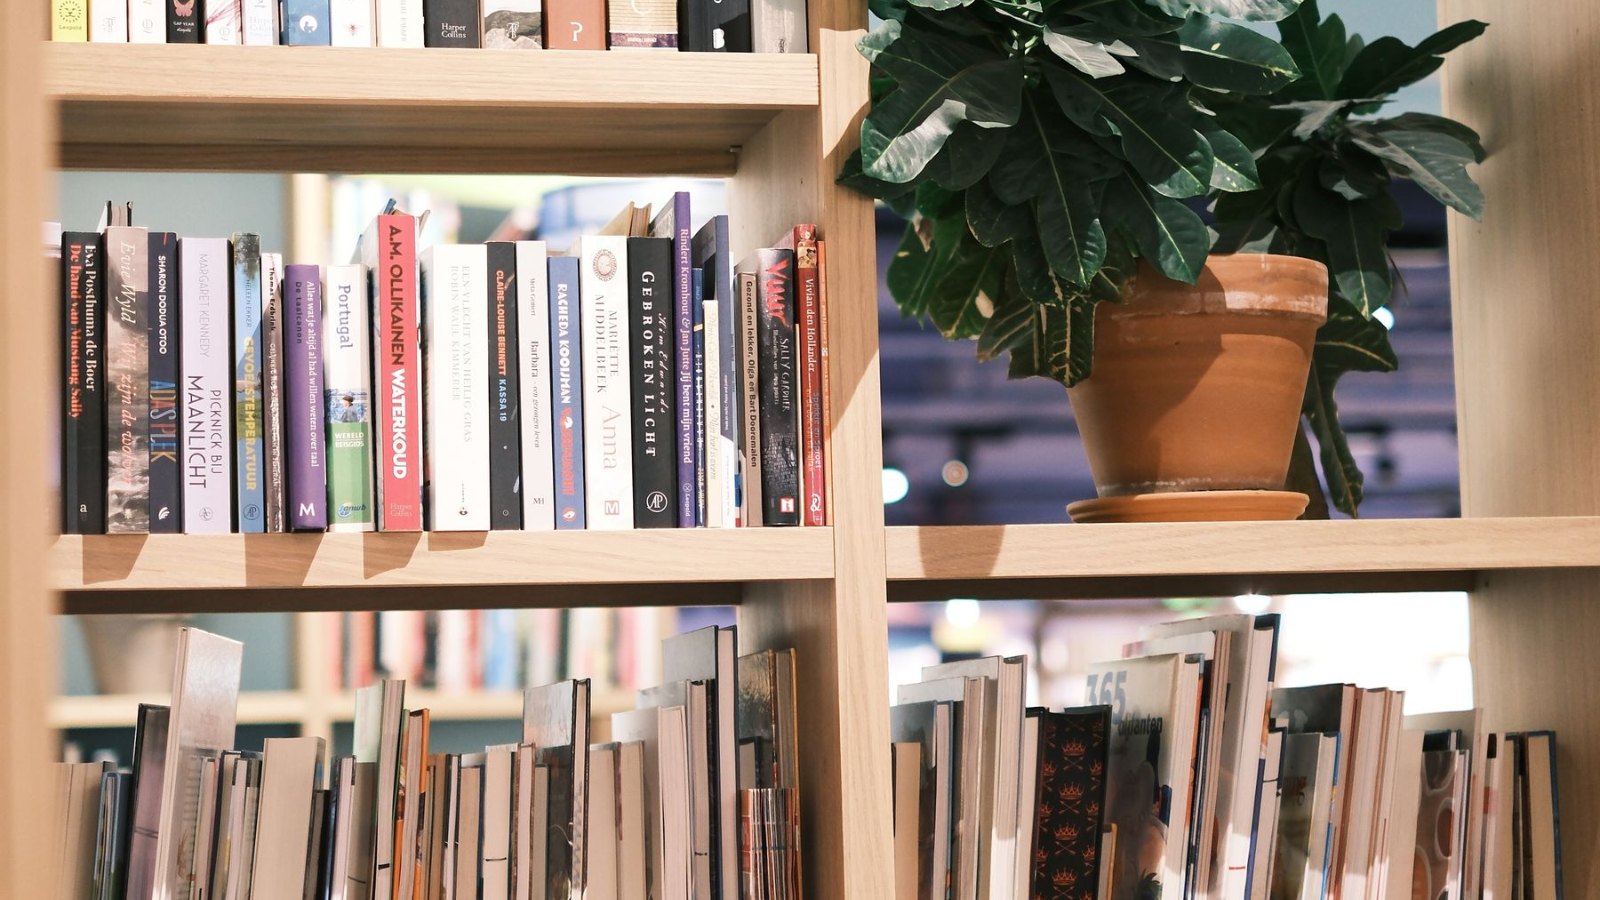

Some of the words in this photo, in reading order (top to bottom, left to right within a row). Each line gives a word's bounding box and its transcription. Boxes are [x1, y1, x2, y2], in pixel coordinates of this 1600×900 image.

[58, 24, 82, 32] Leopold
[441, 22, 467, 32] Harper
[441, 30, 467, 38] Collins
[70, 245, 82, 263] De
[85, 245, 97, 267] Eva
[389, 225, 402, 260] A.M.
[680, 229, 691, 264] Rindert
[120, 241, 136, 280] Evie
[158, 255, 167, 293] SHARON
[71, 265, 83, 299] hand
[198, 253, 211, 308] MARGARET
[296, 281, 303, 293] De
[306, 281, 317, 301] Alles
[451, 265, 460, 302] ROBIN
[461, 266, 471, 287] EEN
[682, 266, 691, 316] Kromhout
[86, 270, 98, 336] Posthuma
[115, 283, 136, 323] Wyld
[496, 270, 507, 335] CLAIRE-LOUISE
[746, 281, 754, 313] Gezond
[766, 259, 792, 329] Vuur
[805, 278, 815, 308] Vivian
[71, 302, 80, 325] van
[159, 294, 167, 327] DODUA
[269, 298, 277, 332] Erdbrink
[306, 318, 316, 327] je
[307, 302, 316, 318] wat
[336, 285, 353, 349] Portugal
[391, 264, 404, 365] OLLIKAINEN
[451, 305, 461, 338] WALL
[462, 291, 472, 338] VLECHT
[558, 283, 569, 337] RACHEDA
[682, 318, 691, 328] &
[748, 315, 754, 327] en
[807, 309, 816, 325] den
[159, 328, 167, 355] OTOO
[199, 310, 211, 358] KENNEDY
[307, 328, 318, 349] altijd
[608, 310, 621, 377] MARIËTTE
[658, 312, 667, 345] Kim
[680, 329, 691, 345] Jan
[747, 328, 756, 358] lekker,
[69, 329, 82, 384] Mustang
[86, 340, 98, 356] de
[117, 340, 137, 370] Wij
[308, 351, 317, 359] al
[462, 342, 472, 365] VAN
[497, 337, 507, 376] BENNETT
[531, 341, 540, 377] Barbara
[595, 295, 607, 394] MIDDELBEEK
[682, 346, 692, 369] Jutte
[779, 338, 791, 369] SALLY
[808, 327, 817, 371] Hollander
[86, 359, 97, 392] Boer
[309, 361, 318, 376] had
[451, 341, 461, 401] KIMMERER
[559, 339, 571, 404] KOOIJMAN
[659, 350, 669, 414] Edwards
[680, 371, 692, 383] Jij
[747, 359, 757, 380] Olga
[69, 387, 83, 418] Sally
[117, 374, 137, 404] zijn
[150, 380, 176, 420] ADAS
[310, 378, 319, 404] willen
[463, 369, 473, 409] HEILIG
[499, 379, 507, 410] KASSA
[682, 385, 692, 406] bent
[750, 381, 755, 393] en
[121, 410, 137, 427] de
[210, 390, 222, 449] PICKNICK
[243, 336, 257, 491] GEVOELSTEMPERATUUR
[310, 405, 318, 431] weten
[391, 368, 407, 479] WATERKOUD
[463, 412, 473, 443] GRAS
[500, 412, 507, 422] 19
[645, 394, 656, 457] LICHT
[681, 408, 692, 431] mijn
[150, 423, 176, 463] PLEK
[188, 375, 207, 489] MAANLICHT
[602, 405, 621, 470] Anna
[311, 451, 320, 467] taal
[683, 433, 693, 464] vriend
[211, 455, 223, 474] BIJ
[299, 502, 316, 516] M
[684, 493, 692, 517] Leopold
[1087, 671, 1127, 725] 365
